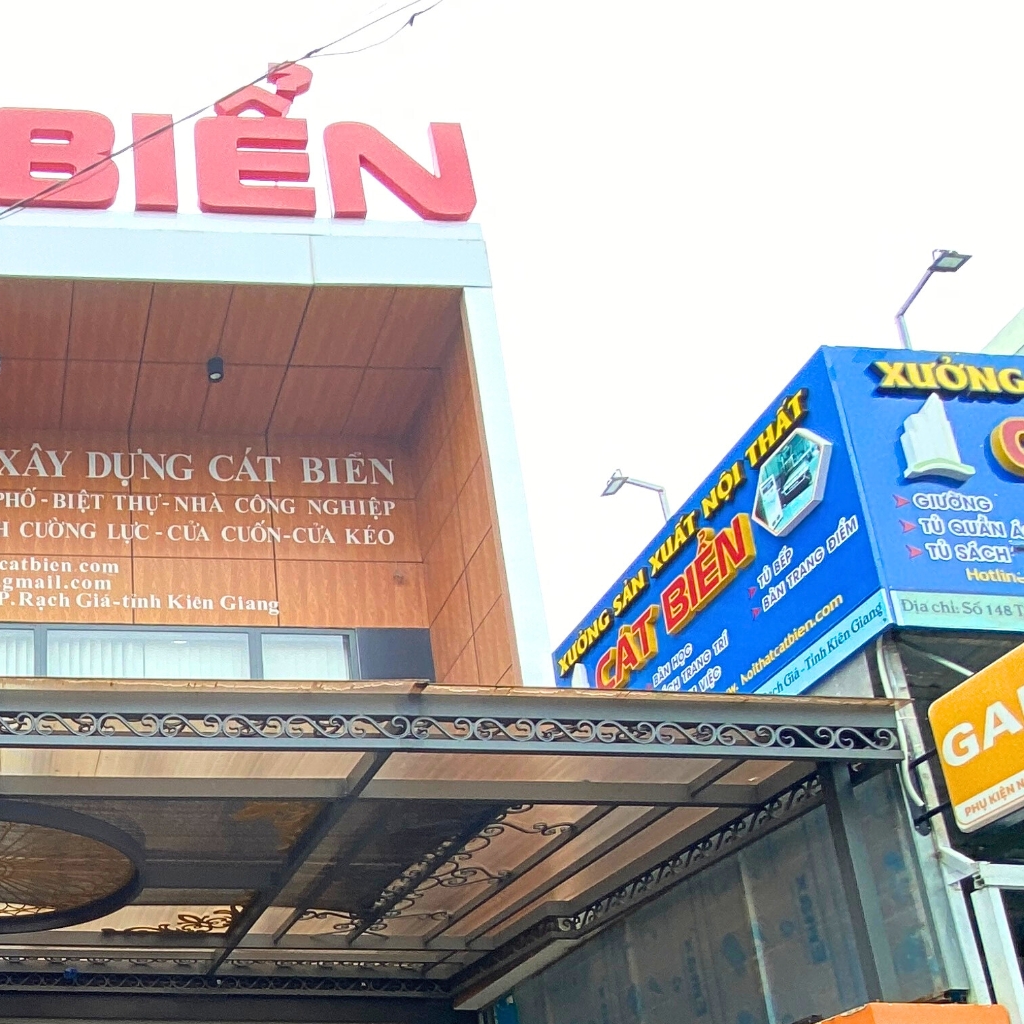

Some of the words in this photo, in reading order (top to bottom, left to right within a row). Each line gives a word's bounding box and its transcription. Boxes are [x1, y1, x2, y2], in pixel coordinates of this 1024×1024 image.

[86, 448, 194, 487] DỰNG
[209, 447, 281, 483] CÁT
[235, 494, 296, 515] CÔNG
[308, 497, 396, 520] NGHIỆP
[913, 491, 994, 513] GIƯỜNG
[19, 517, 97, 539] CƯỜNG
[345, 524, 395, 545] KÉO
[557, 609, 613, 677] XƯỞNG
[611, 566, 648, 617] SẢN
[648, 510, 698, 577] XUẤT
[700, 460, 745, 519] NỘI
[744, 388, 806, 469] THẤT
[918, 514, 946, 535] TỦ
[948, 513, 1008, 539] QUẦN
[761, 582, 787, 612] BÀN
[786, 546, 826, 590] TRANG
[826, 514, 859, 554] ĐIỂM
[924, 538, 953, 561] TỦ
[955, 540, 1013, 564] SÁCH
[757, 565, 772, 590] TỦ
[772, 545, 794, 576] BẾP
[167, 594, 214, 611] Kiên
[219, 595, 280, 616] Giang
[595, 604, 659, 690] CÁT
[661, 513, 755, 635] BIỂN
[900, 598, 929, 614] Địa
[986, 604, 1013, 617] 148
[826, 630, 851, 655] Kiên
[851, 602, 884, 634] Giang
[671, 643, 693, 669] HỌC
[681, 649, 712, 684] TRANG
[964, 797, 987, 817] PHỤ
[989, 786, 1016, 805] KIỆN
